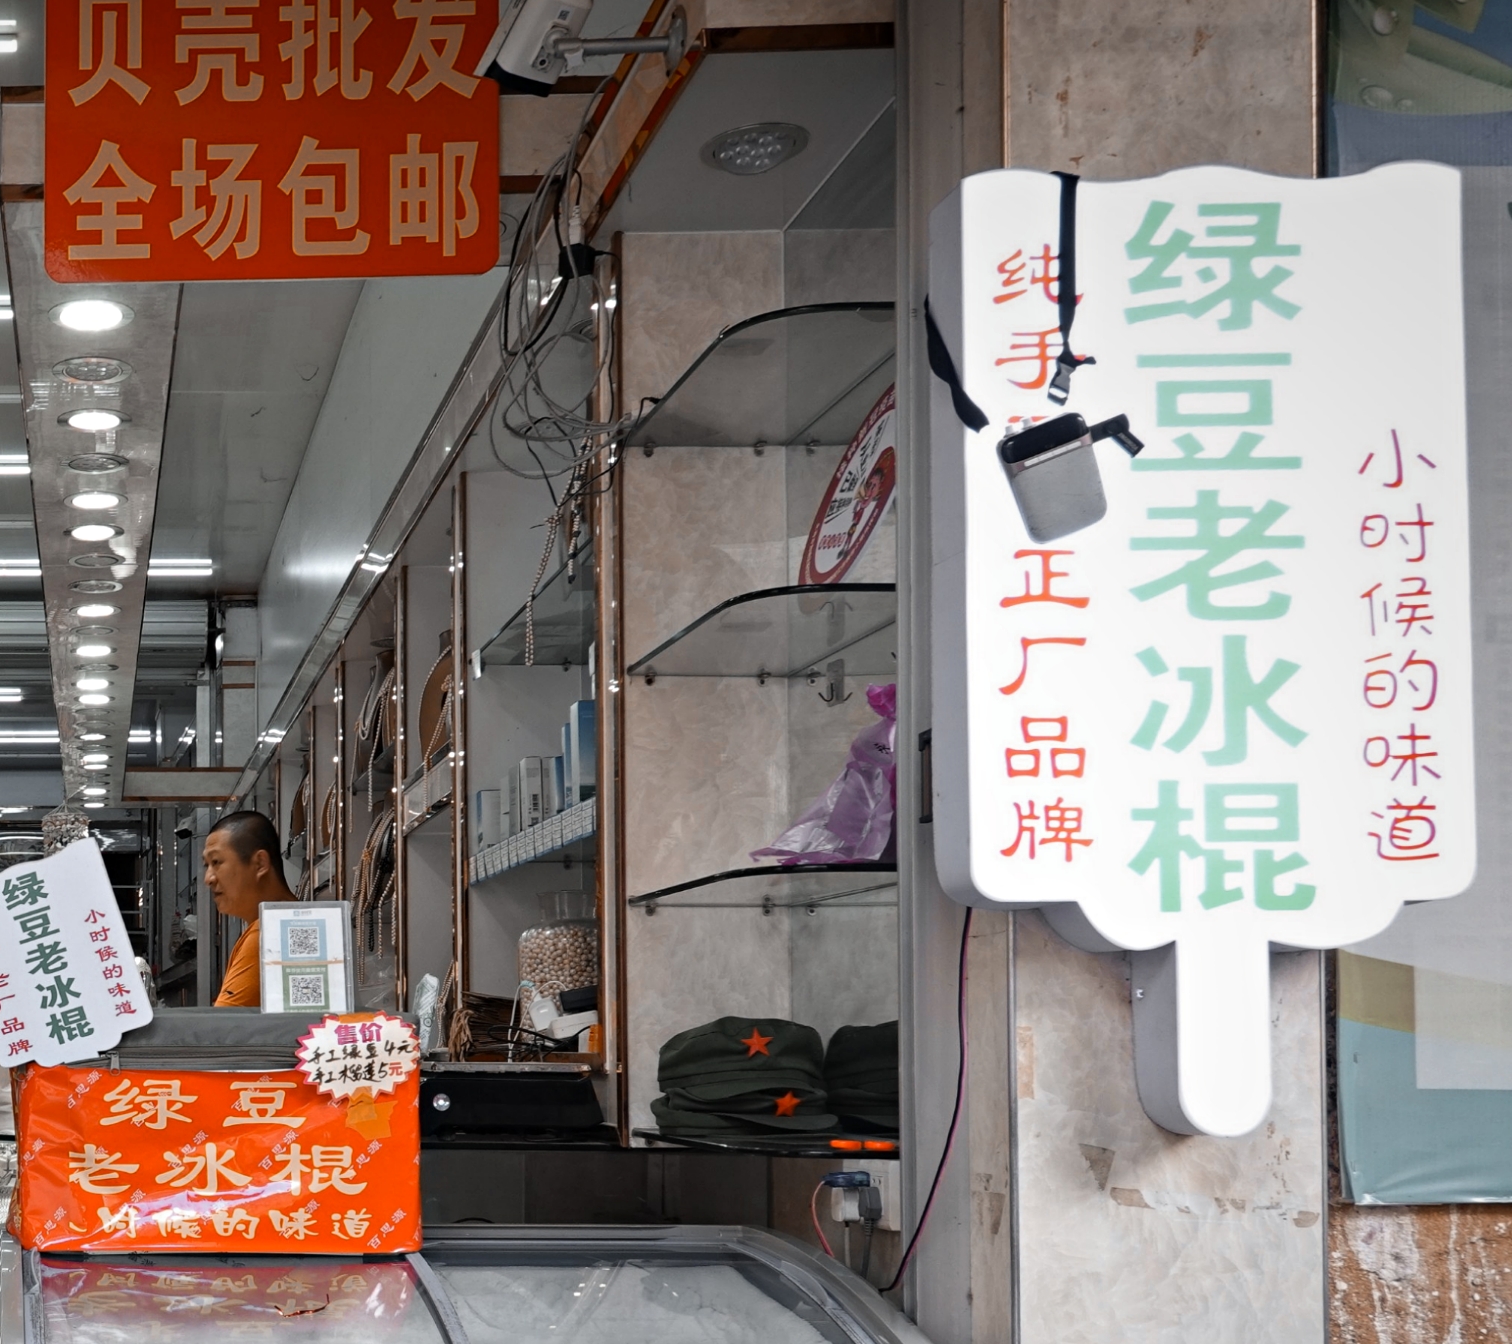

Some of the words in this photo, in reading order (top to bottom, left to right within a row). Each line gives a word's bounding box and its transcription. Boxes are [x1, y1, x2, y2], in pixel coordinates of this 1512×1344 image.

[68, 0, 481, 107] 贝壳批发
[63, 134, 480, 261] 全场包邮
[1124, 200, 1316, 912] 绿豆老冰棍
[1358, 428, 1441, 863] 小时候的味道
[999, 549, 1093, 862] 正厂品牌
[1, 871, 94, 1045] 绿豆老冰棍
[84, 909, 137, 1017] 小时候的味道
[334, 1023, 383, 1046] 售价
[100, 1079, 307, 1130] 绿豆
[69, 1142, 367, 1197] 老冰棍
[69, 1208, 371, 1241] 时候的味道
